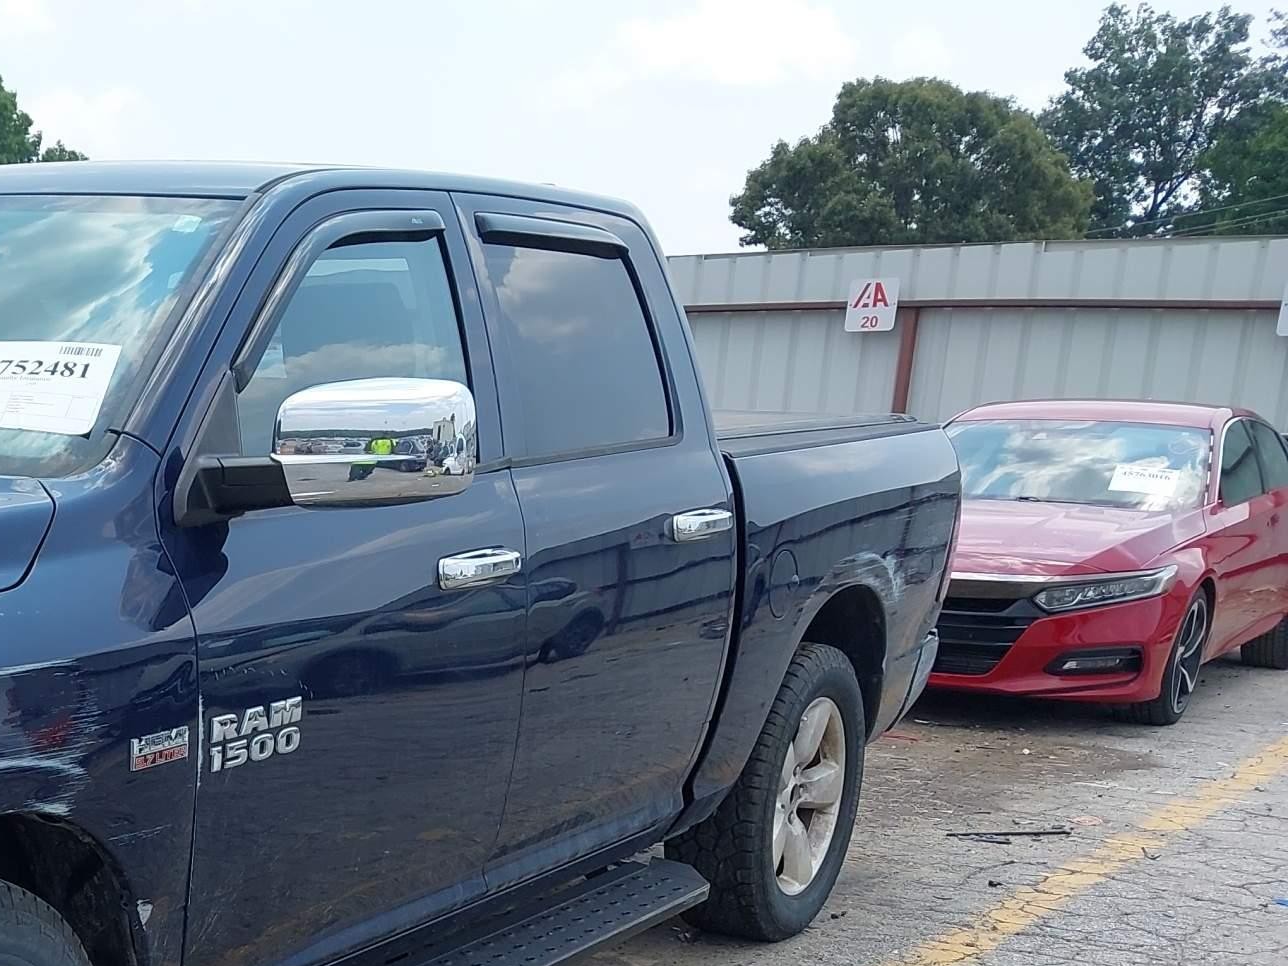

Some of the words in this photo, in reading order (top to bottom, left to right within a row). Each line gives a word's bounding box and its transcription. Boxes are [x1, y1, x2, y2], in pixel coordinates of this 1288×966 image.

[860, 316, 879, 329] 20
[211, 696, 302, 743] RAM
[132, 726, 189, 755] HEMI
[210, 726, 300, 773] 1500
